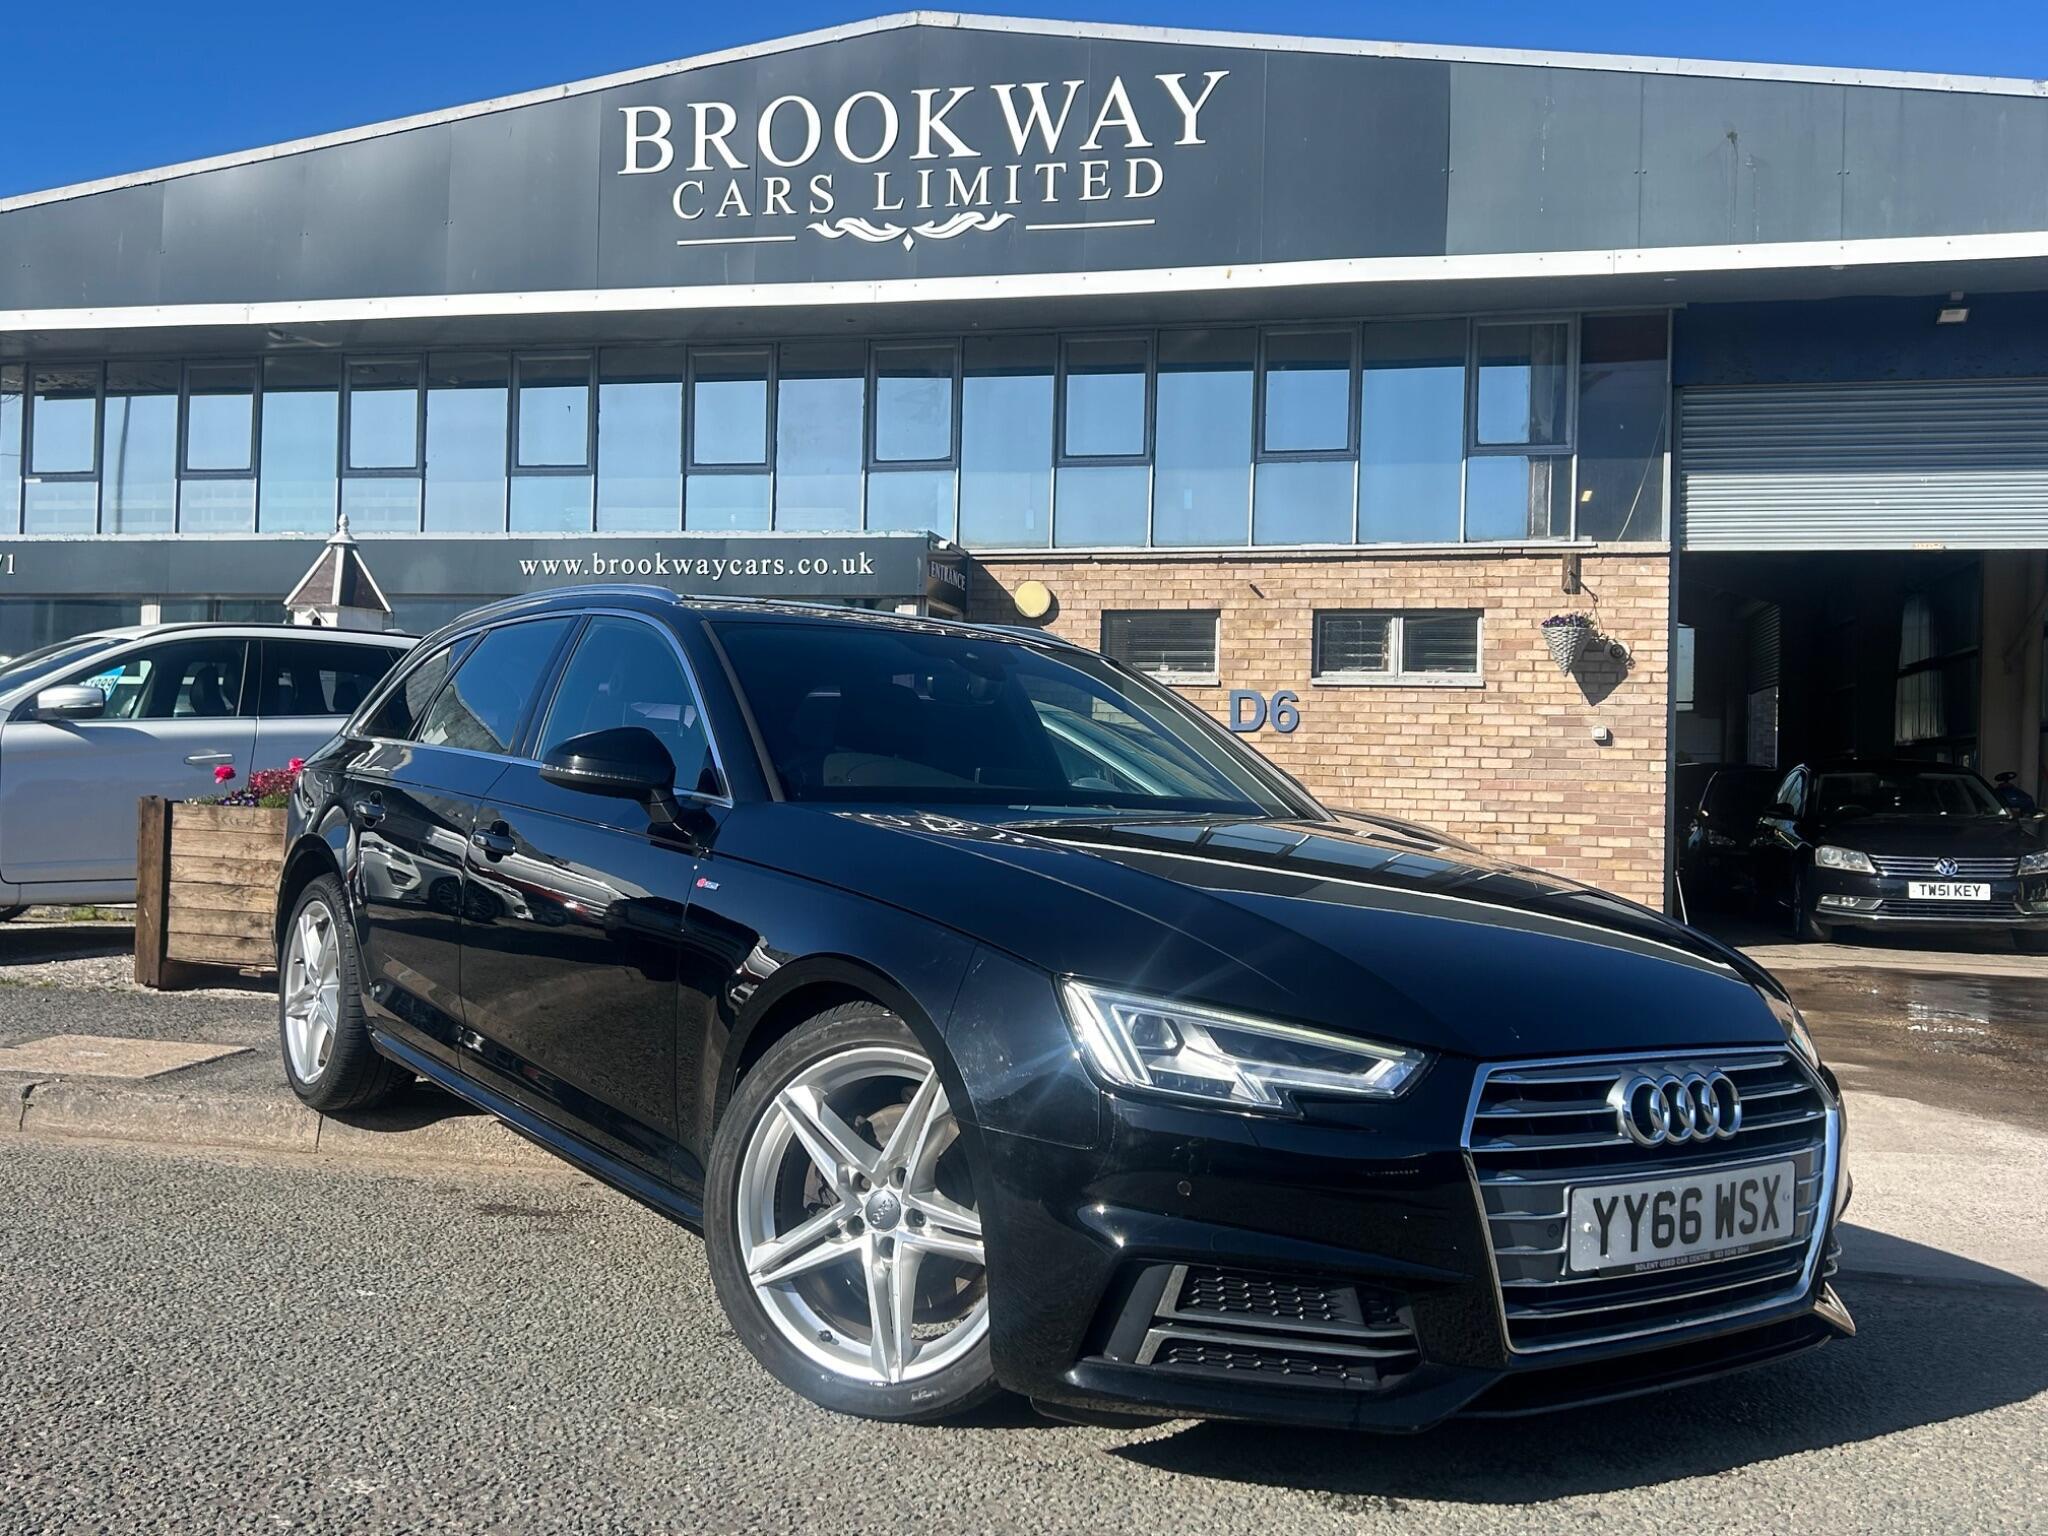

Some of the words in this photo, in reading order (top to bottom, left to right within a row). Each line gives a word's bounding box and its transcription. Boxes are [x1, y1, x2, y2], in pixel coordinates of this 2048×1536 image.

[617, 70, 1230, 175] BROOKWAY
[672, 173, 836, 220] CARS
[873, 157, 1165, 212] LIMITED
[519, 552, 876, 581] www.brookwaycars.co.uk
[930, 560, 967, 591] ENTRANCE
[1229, 688, 1300, 734] D6
[1954, 884, 1981, 897] KEY
[1592, 1186, 1703, 1257] YY66
[1714, 1173, 1782, 1241] WSX
